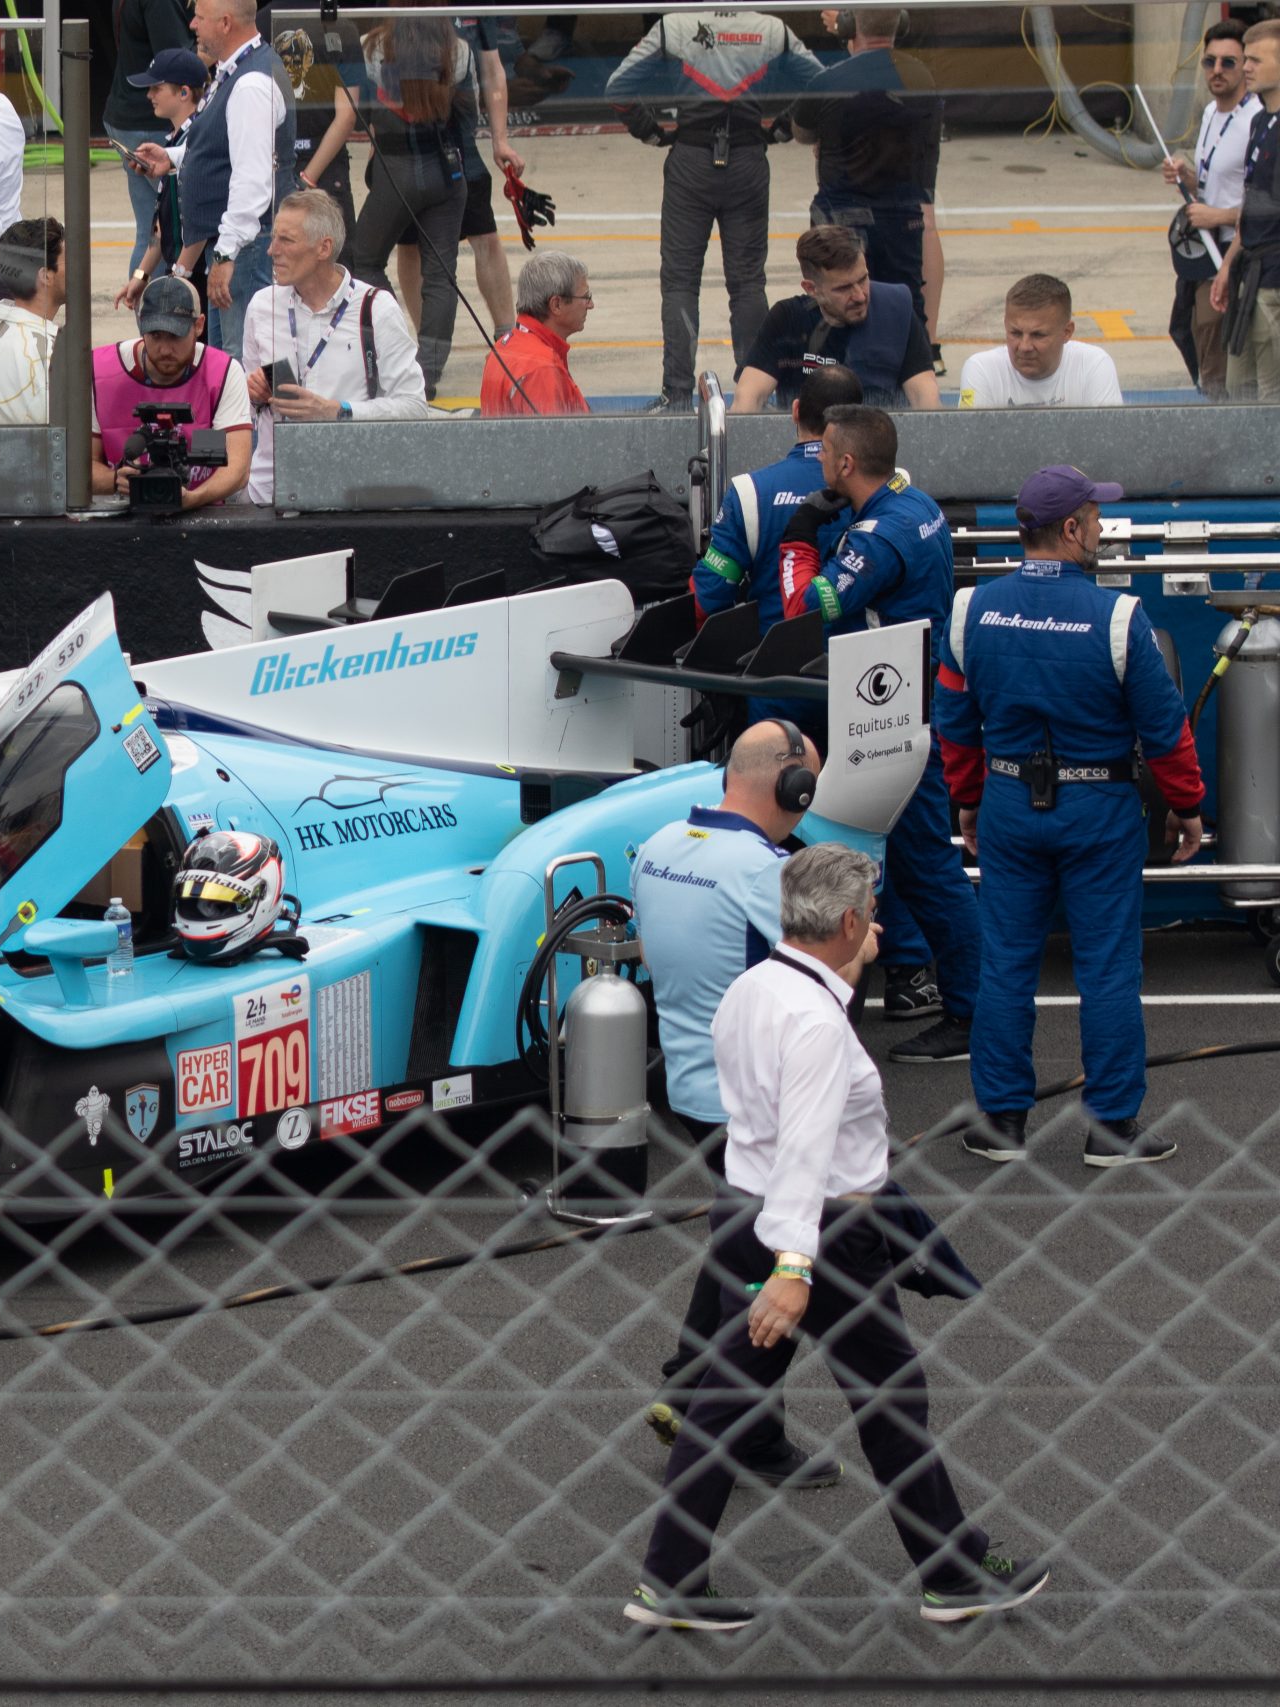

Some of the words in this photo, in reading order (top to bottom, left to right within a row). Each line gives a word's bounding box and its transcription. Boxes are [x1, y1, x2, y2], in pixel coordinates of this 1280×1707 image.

[979, 611, 1092, 633] Glickenhaus
[58, 633, 84, 667] 530
[249, 632, 478, 696] Glickenhaus
[848, 713, 910, 738] Equitus.us
[867, 744, 903, 760] Cyberspatial
[294, 821, 334, 851] HK
[332, 803, 458, 844] MOTORCARS
[641, 860, 718, 889] Glickenhaus
[182, 1049, 229, 1075] HYPER
[240, 1030, 307, 1117] 709
[182, 1070, 229, 1108] CAR
[388, 1094, 422, 1108] noberasco
[434, 1095, 471, 1109] GREENTECH
[321, 1090, 380, 1128] FIKSE
[351, 1116, 380, 1129] WHEELS
[178, 1121, 253, 1158] STALOC
[179, 1156, 206, 1168] GOLDEN
[208, 1153, 225, 1161] STAR
